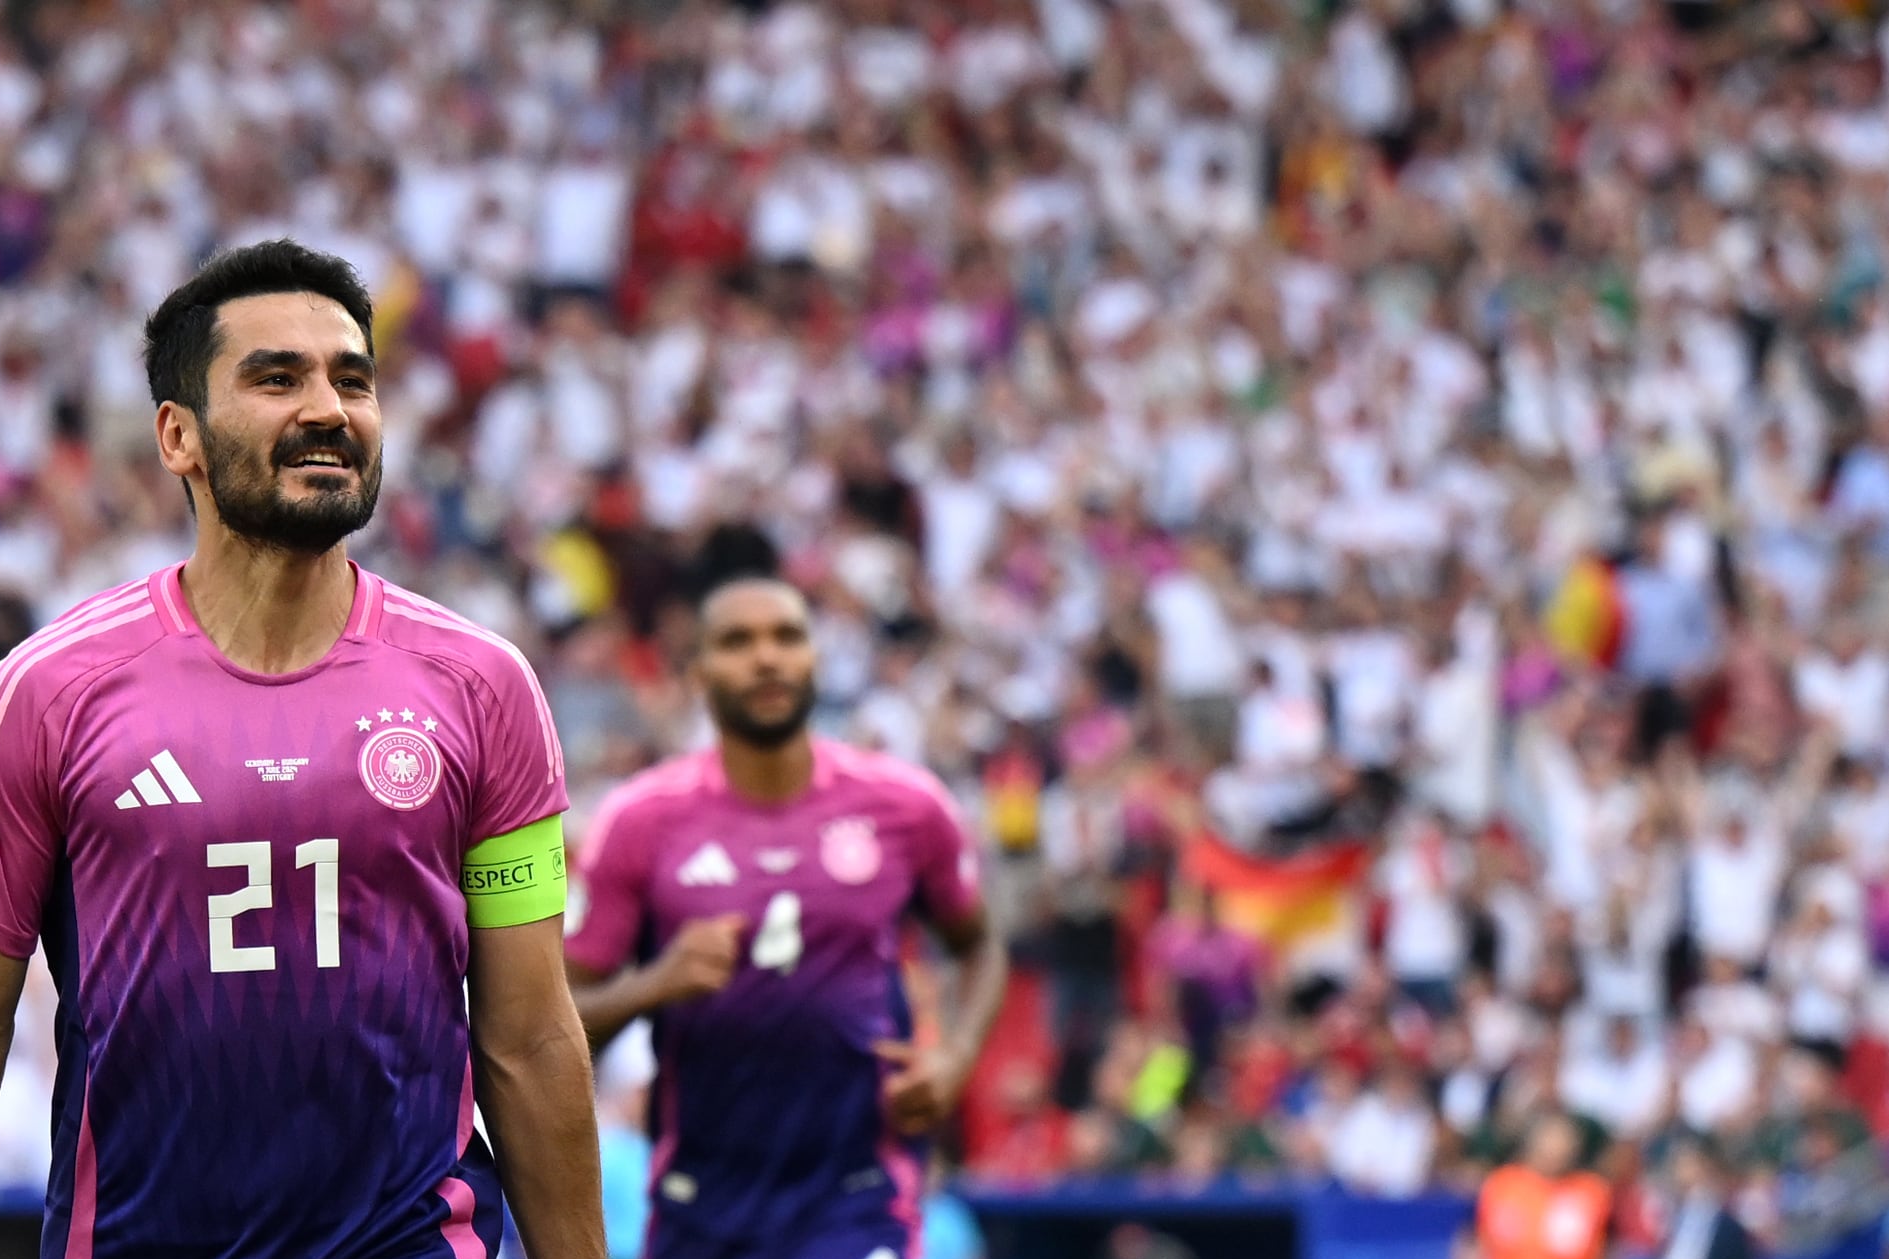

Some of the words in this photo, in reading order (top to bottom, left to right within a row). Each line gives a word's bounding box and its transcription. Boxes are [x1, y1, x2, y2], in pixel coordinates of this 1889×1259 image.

[377, 737, 423, 753] DEUTSCHER
[375, 775, 429, 797] FUSSBALL-BUND
[463, 862, 534, 889] ESPECT
[206, 838, 340, 973] 21
[751, 890, 803, 976] 4
